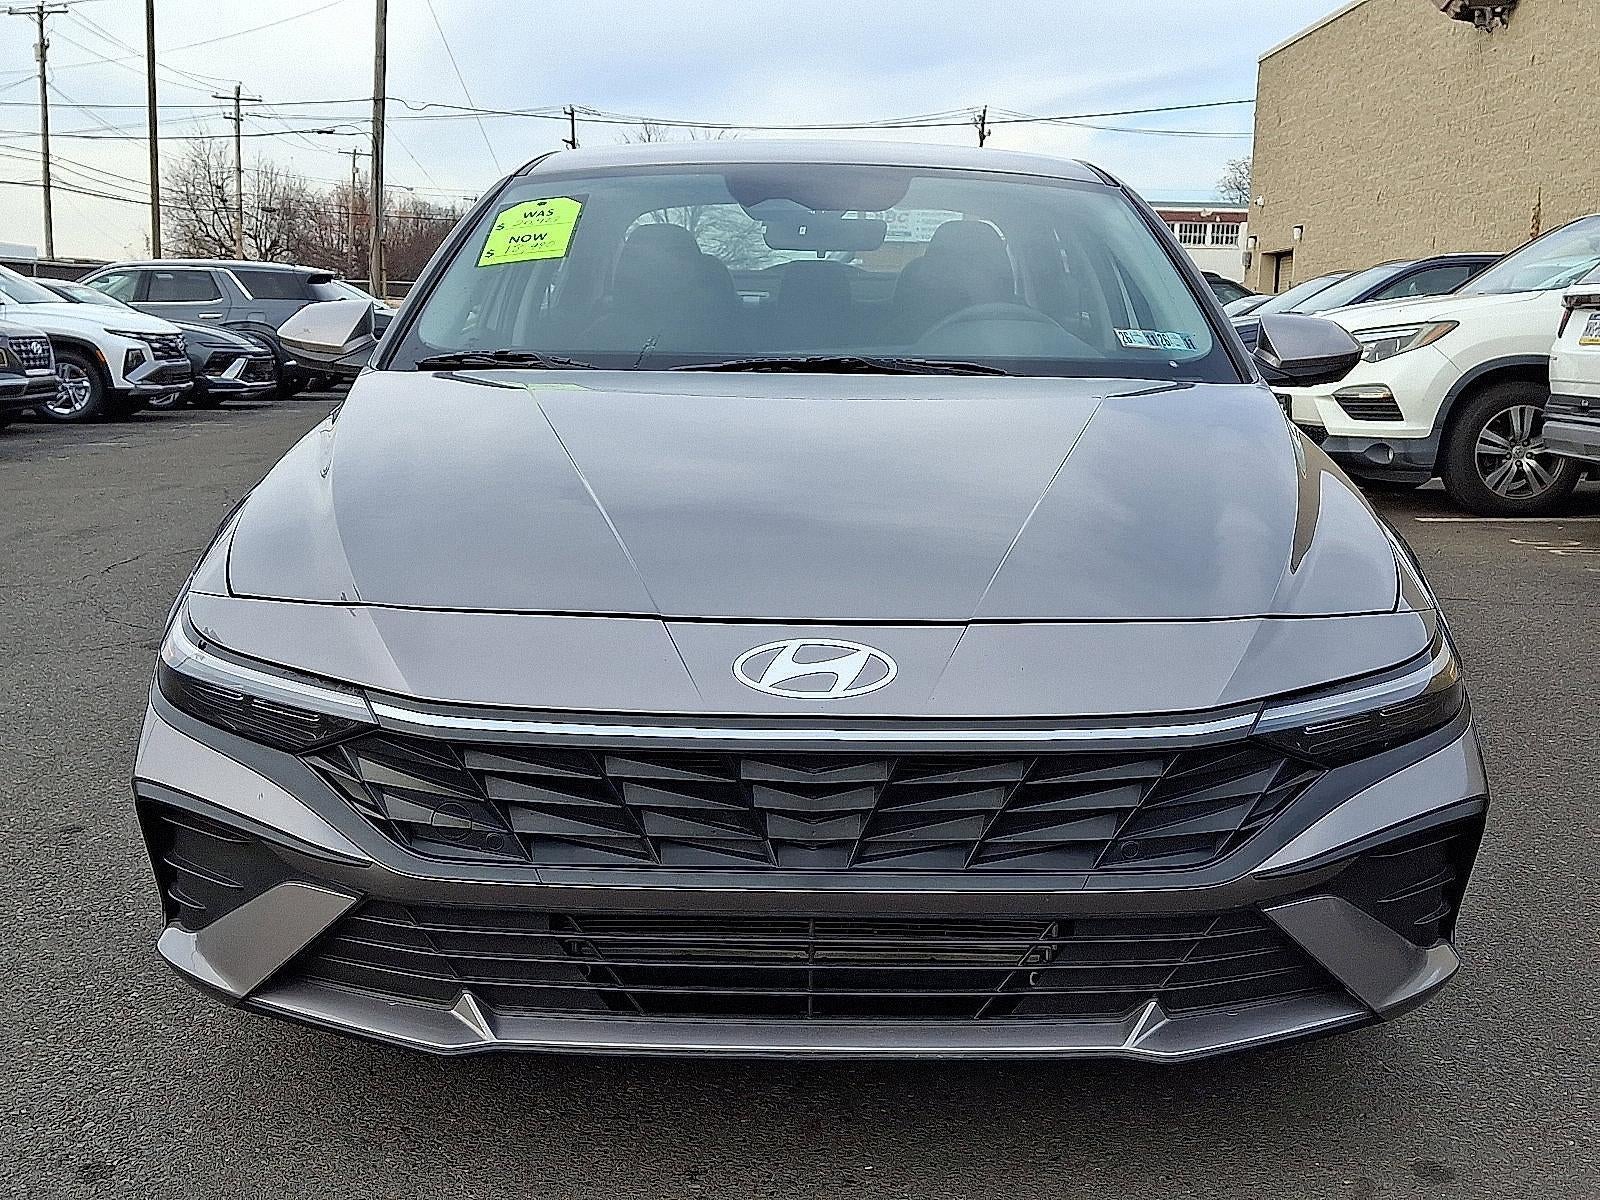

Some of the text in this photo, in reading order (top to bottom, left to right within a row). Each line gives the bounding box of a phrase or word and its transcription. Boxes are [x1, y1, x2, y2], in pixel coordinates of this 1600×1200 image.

[523, 208, 554, 218] WAS
[495, 223, 505, 231] $
[508, 232, 547, 243] NOW
[485, 249, 495, 259] $
[1118, 331, 1133, 344] 26
[1157, 333, 1171, 347] 26
